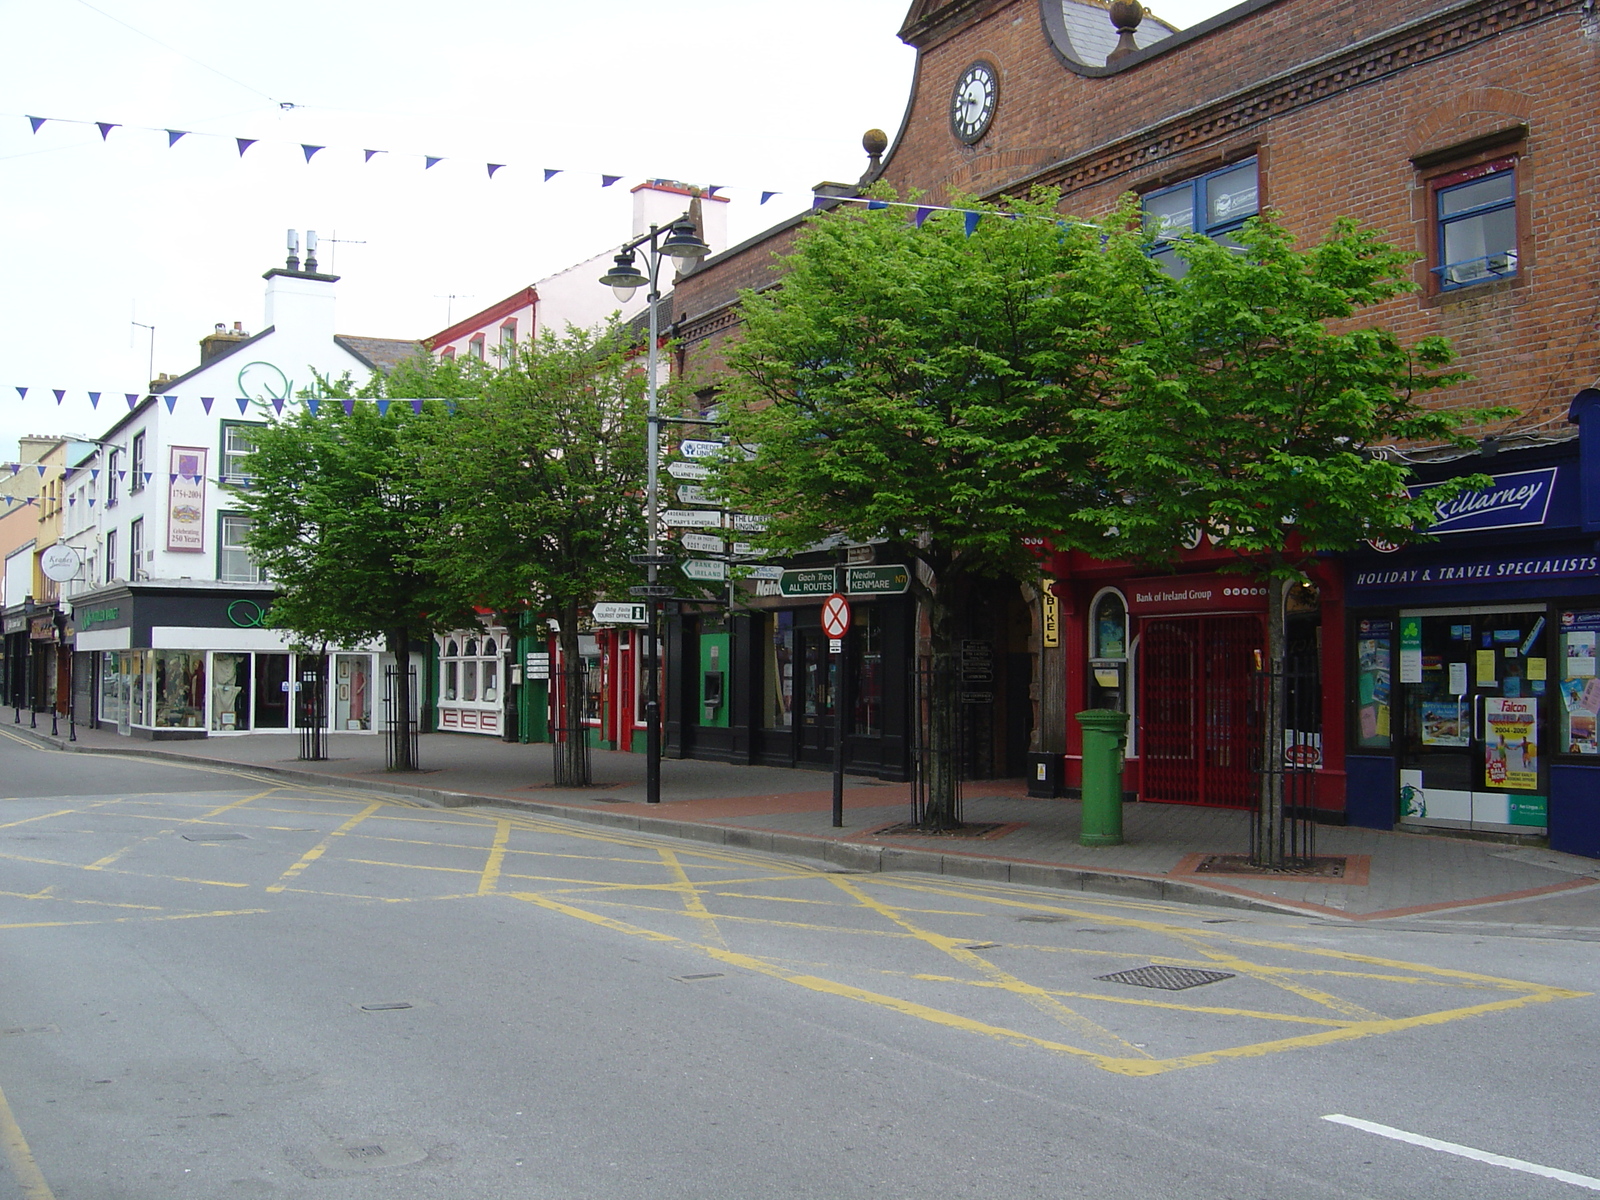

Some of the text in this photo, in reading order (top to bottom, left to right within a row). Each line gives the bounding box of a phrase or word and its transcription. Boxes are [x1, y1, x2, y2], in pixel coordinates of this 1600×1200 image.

[696, 443, 720, 451] CREDIT
[173, 489, 202, 499] 1754-2004
[1433, 481, 1543, 519] Killarney
[172, 528, 200, 536] Celebrating
[183, 535, 200, 543] Years
[687, 541, 718, 551] POST OFFICE
[1356, 556, 1599, 586] HOLIDAY & TRAVEL SPECIALISTS
[797, 572, 833, 582] Gach Treo
[895, 575, 907, 583] N71
[788, 582, 833, 592] ALL ROUTES
[851, 580, 890, 589] KENMARE
[1135, 589, 1212, 603] Bank of Ireland Group
[1223, 587, 1270, 596] CHANG
[1046, 597, 1056, 631] BIKE
[1500, 700, 1527, 712] Falcon
